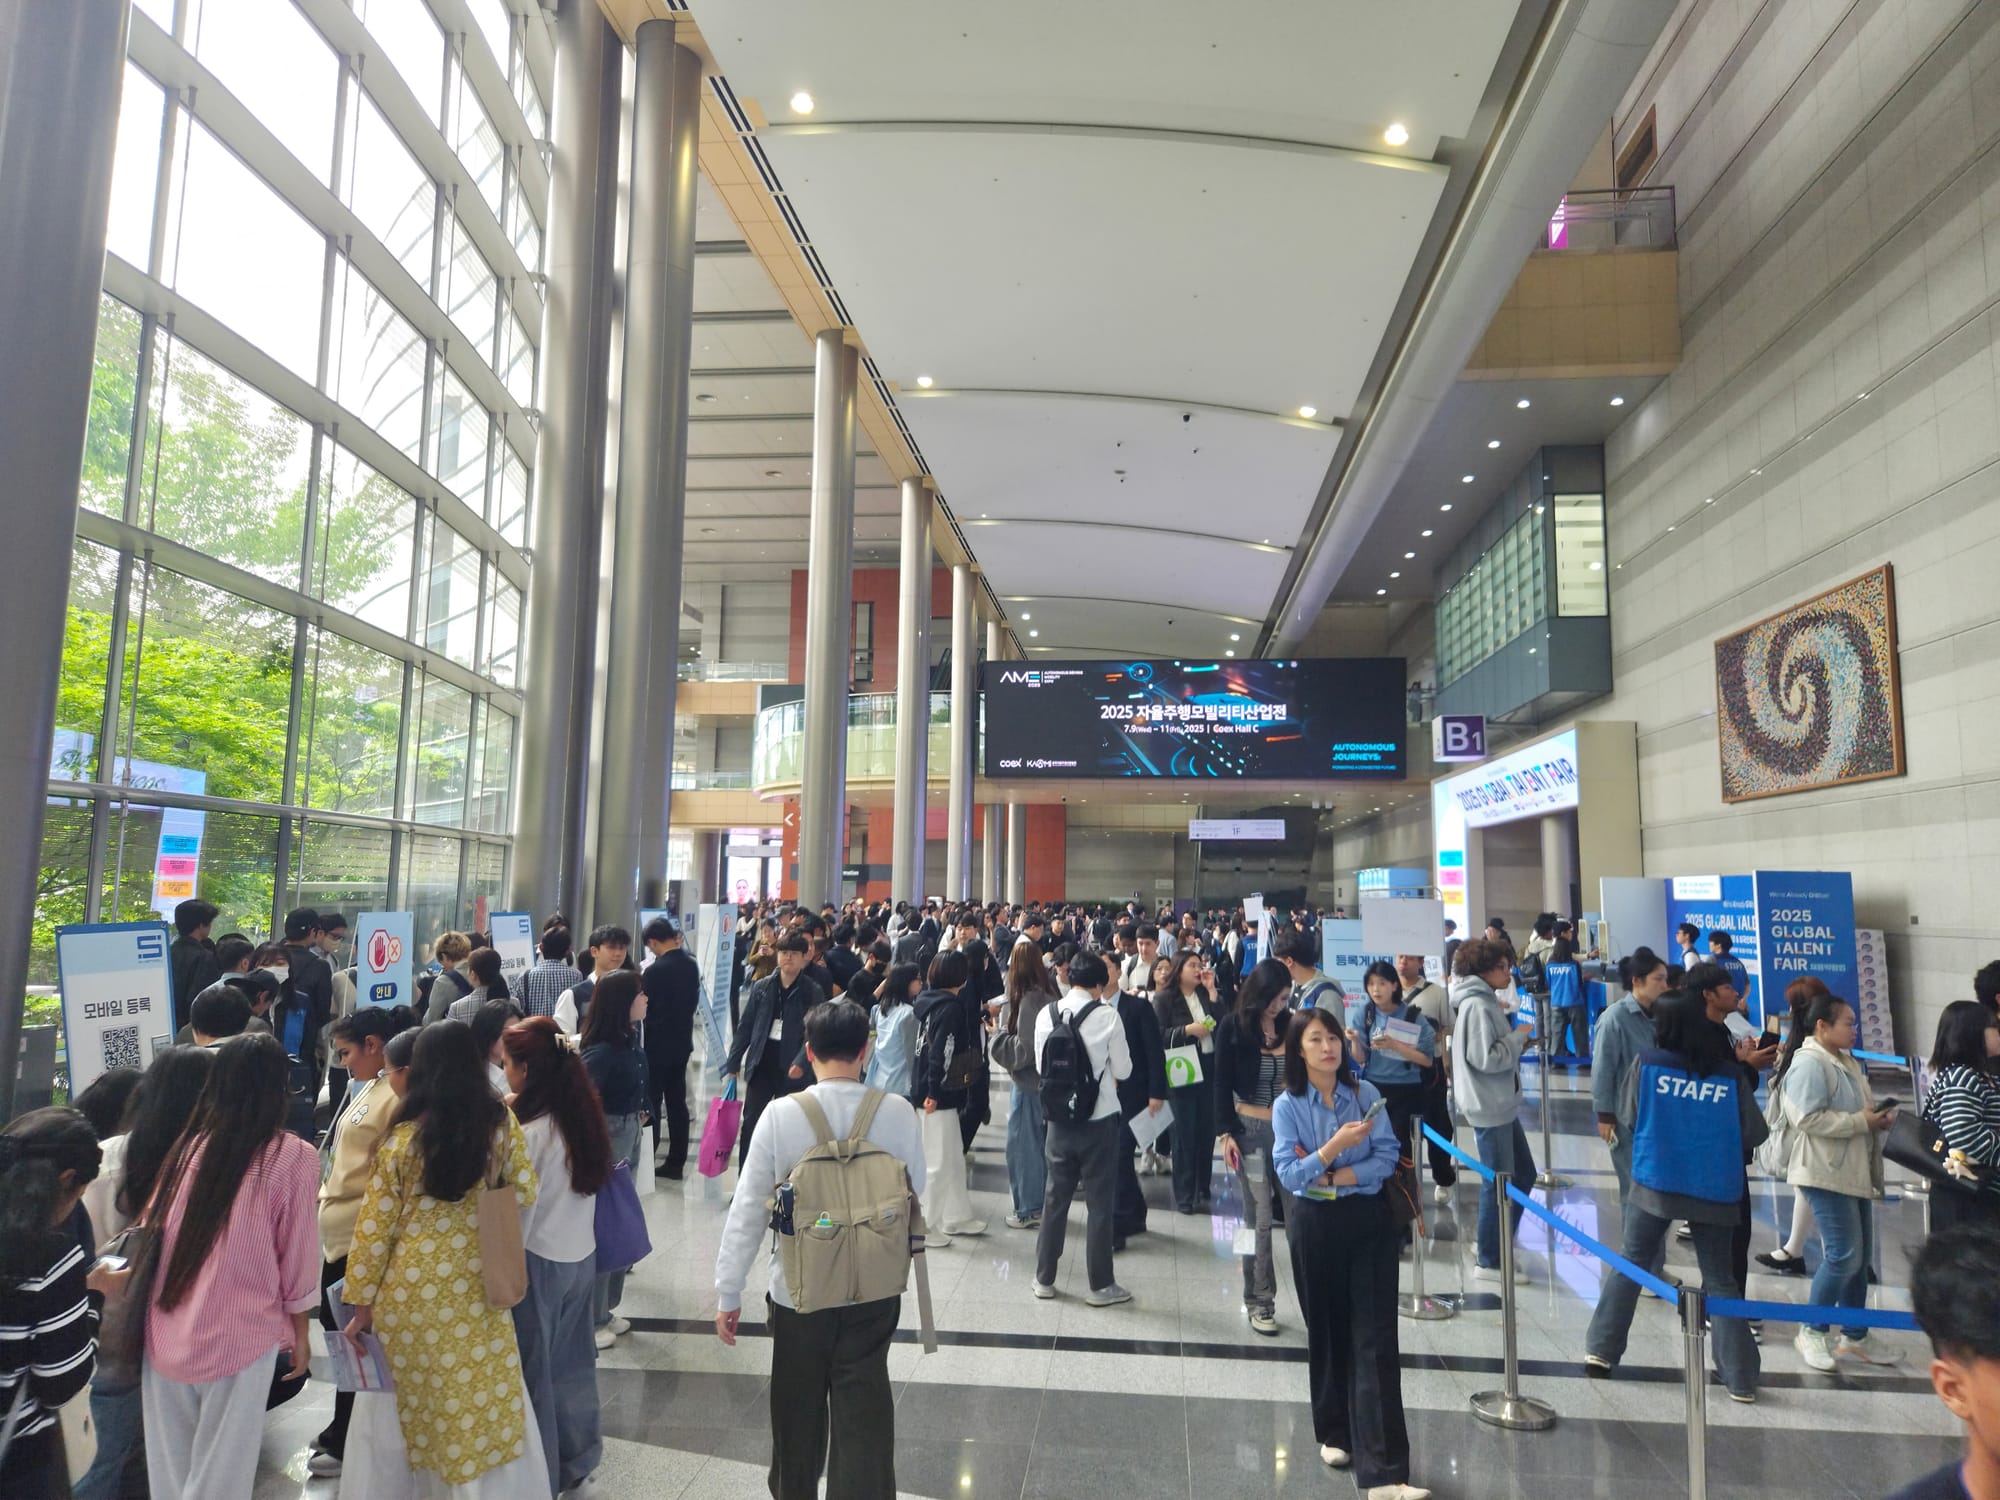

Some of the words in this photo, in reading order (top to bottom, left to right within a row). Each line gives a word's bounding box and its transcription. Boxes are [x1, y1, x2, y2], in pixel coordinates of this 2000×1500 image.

[1000, 671, 1040, 683] AME
[1100, 705, 1133, 719] 2025
[1136, 704, 1287, 721] 자율주행모빌리티산업전
[1185, 724, 1204, 733] 2025
[1213, 724, 1234, 733] Coex
[1235, 724, 1251, 733] Hall
[1252, 724, 1260, 733] C
[1333, 743, 1396, 751] AUTONOMOUS
[1475, 778, 1517, 806] GLOBAL
[1504, 764, 1551, 797] TALENT
[1544, 758, 1578, 788] FAIR
[1705, 914, 1736, 931] GLOBAL
[1771, 909, 1812, 922] 2025
[1771, 925, 1836, 939] GLOBAL
[1773, 941, 1834, 956] TALENT
[1773, 957, 1808, 971] FAIR
[377, 985, 392, 999] 안내
[84, 1000, 123, 1019] 모바일
[127, 997, 151, 1015] 등록
[1656, 1075, 1729, 1103] STAFF
